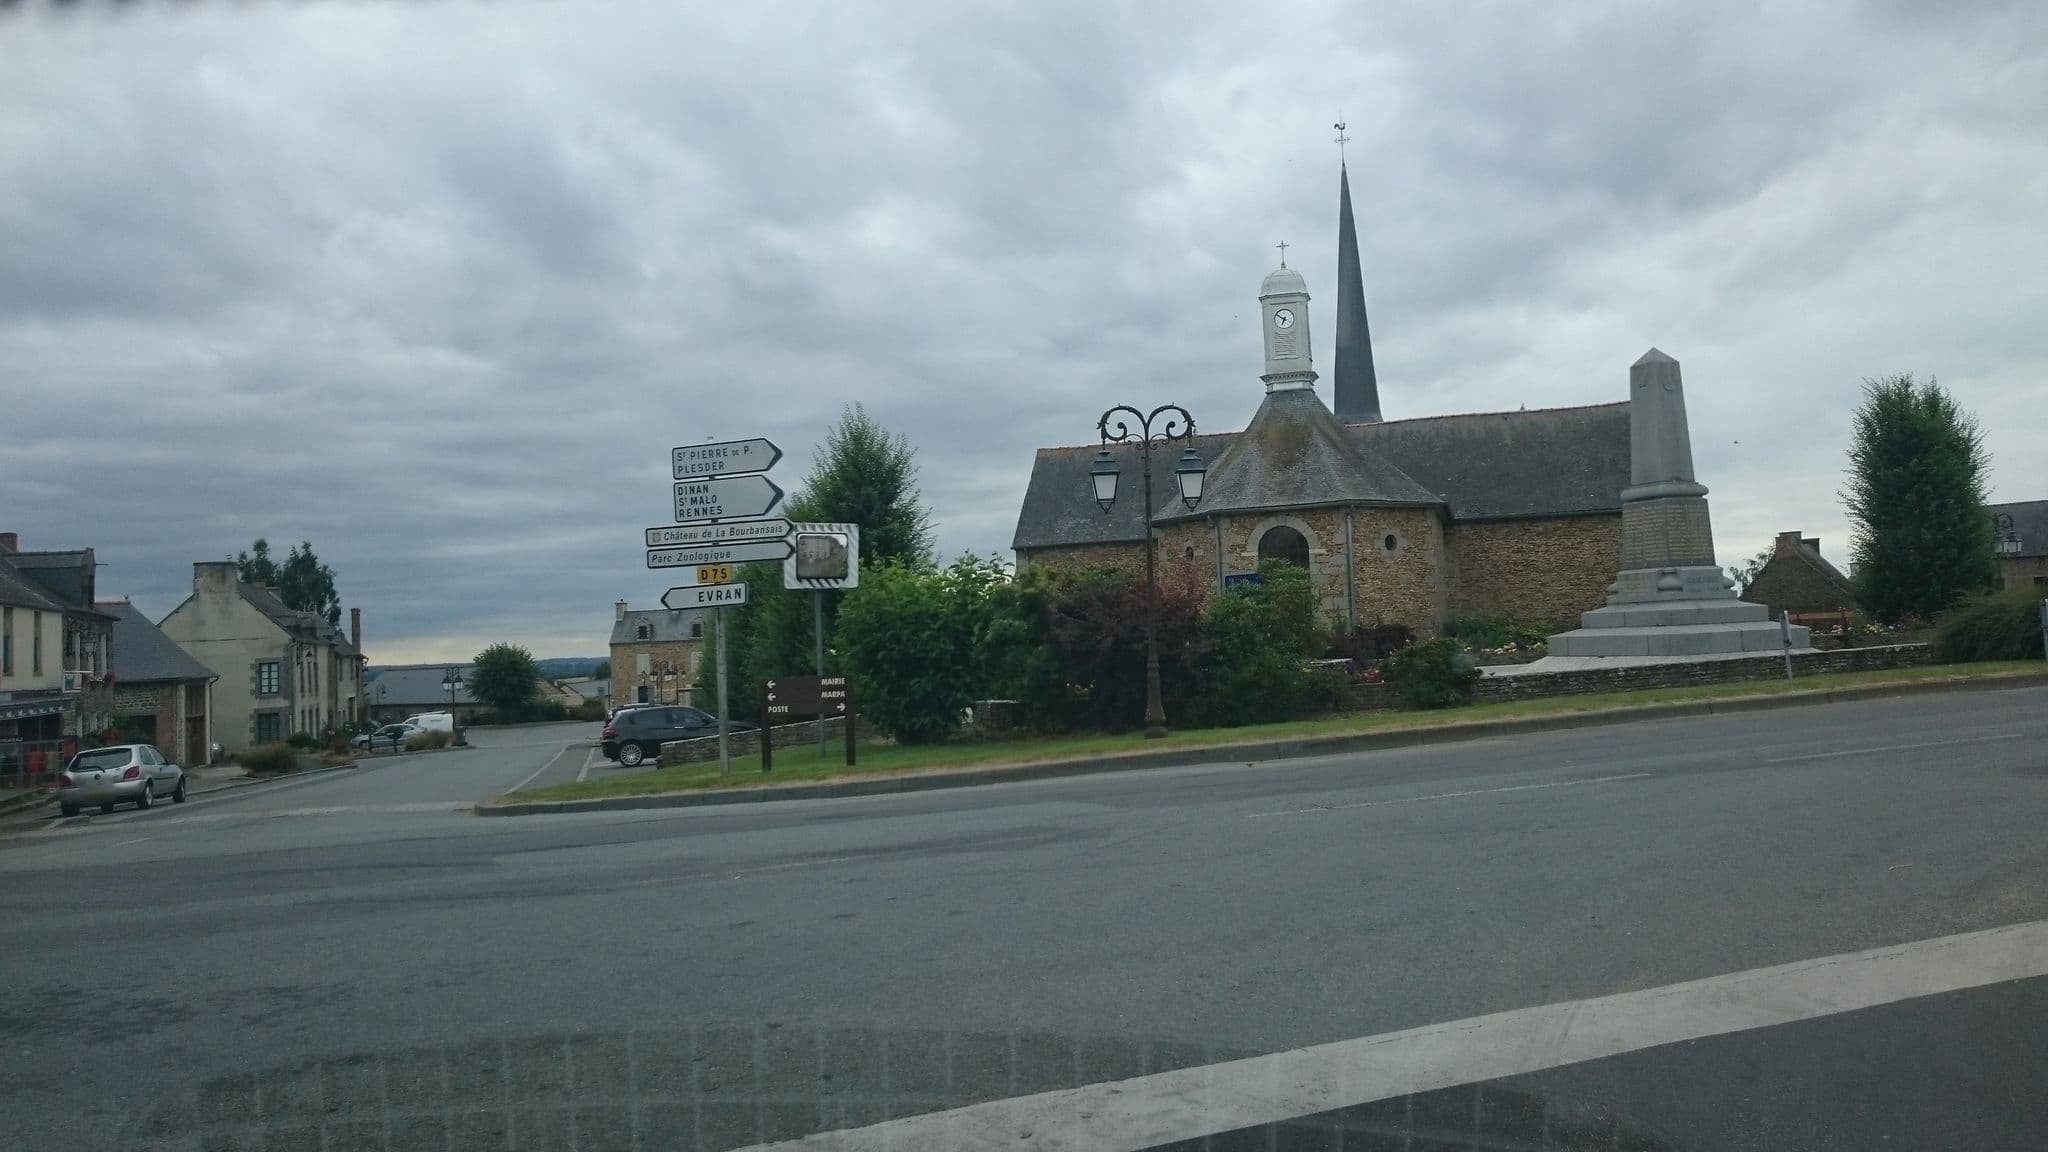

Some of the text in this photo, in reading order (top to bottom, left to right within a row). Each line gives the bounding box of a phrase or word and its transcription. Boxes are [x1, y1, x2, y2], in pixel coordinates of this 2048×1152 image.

[690, 448, 728, 460] PIERRE
[743, 445, 753, 455] P.
[677, 461, 725, 474] PLESDER
[677, 485, 709, 496] DINAN
[690, 494, 717, 506] MALO
[679, 506, 723, 518] RENNES
[663, 524, 783, 541] Château de La Bourbansais
[652, 550, 731, 563] Parc Zoologique
[701, 568, 728, 580] D 75
[698, 588, 741, 602] EVRAN
[768, 705, 788, 713] POSTE
